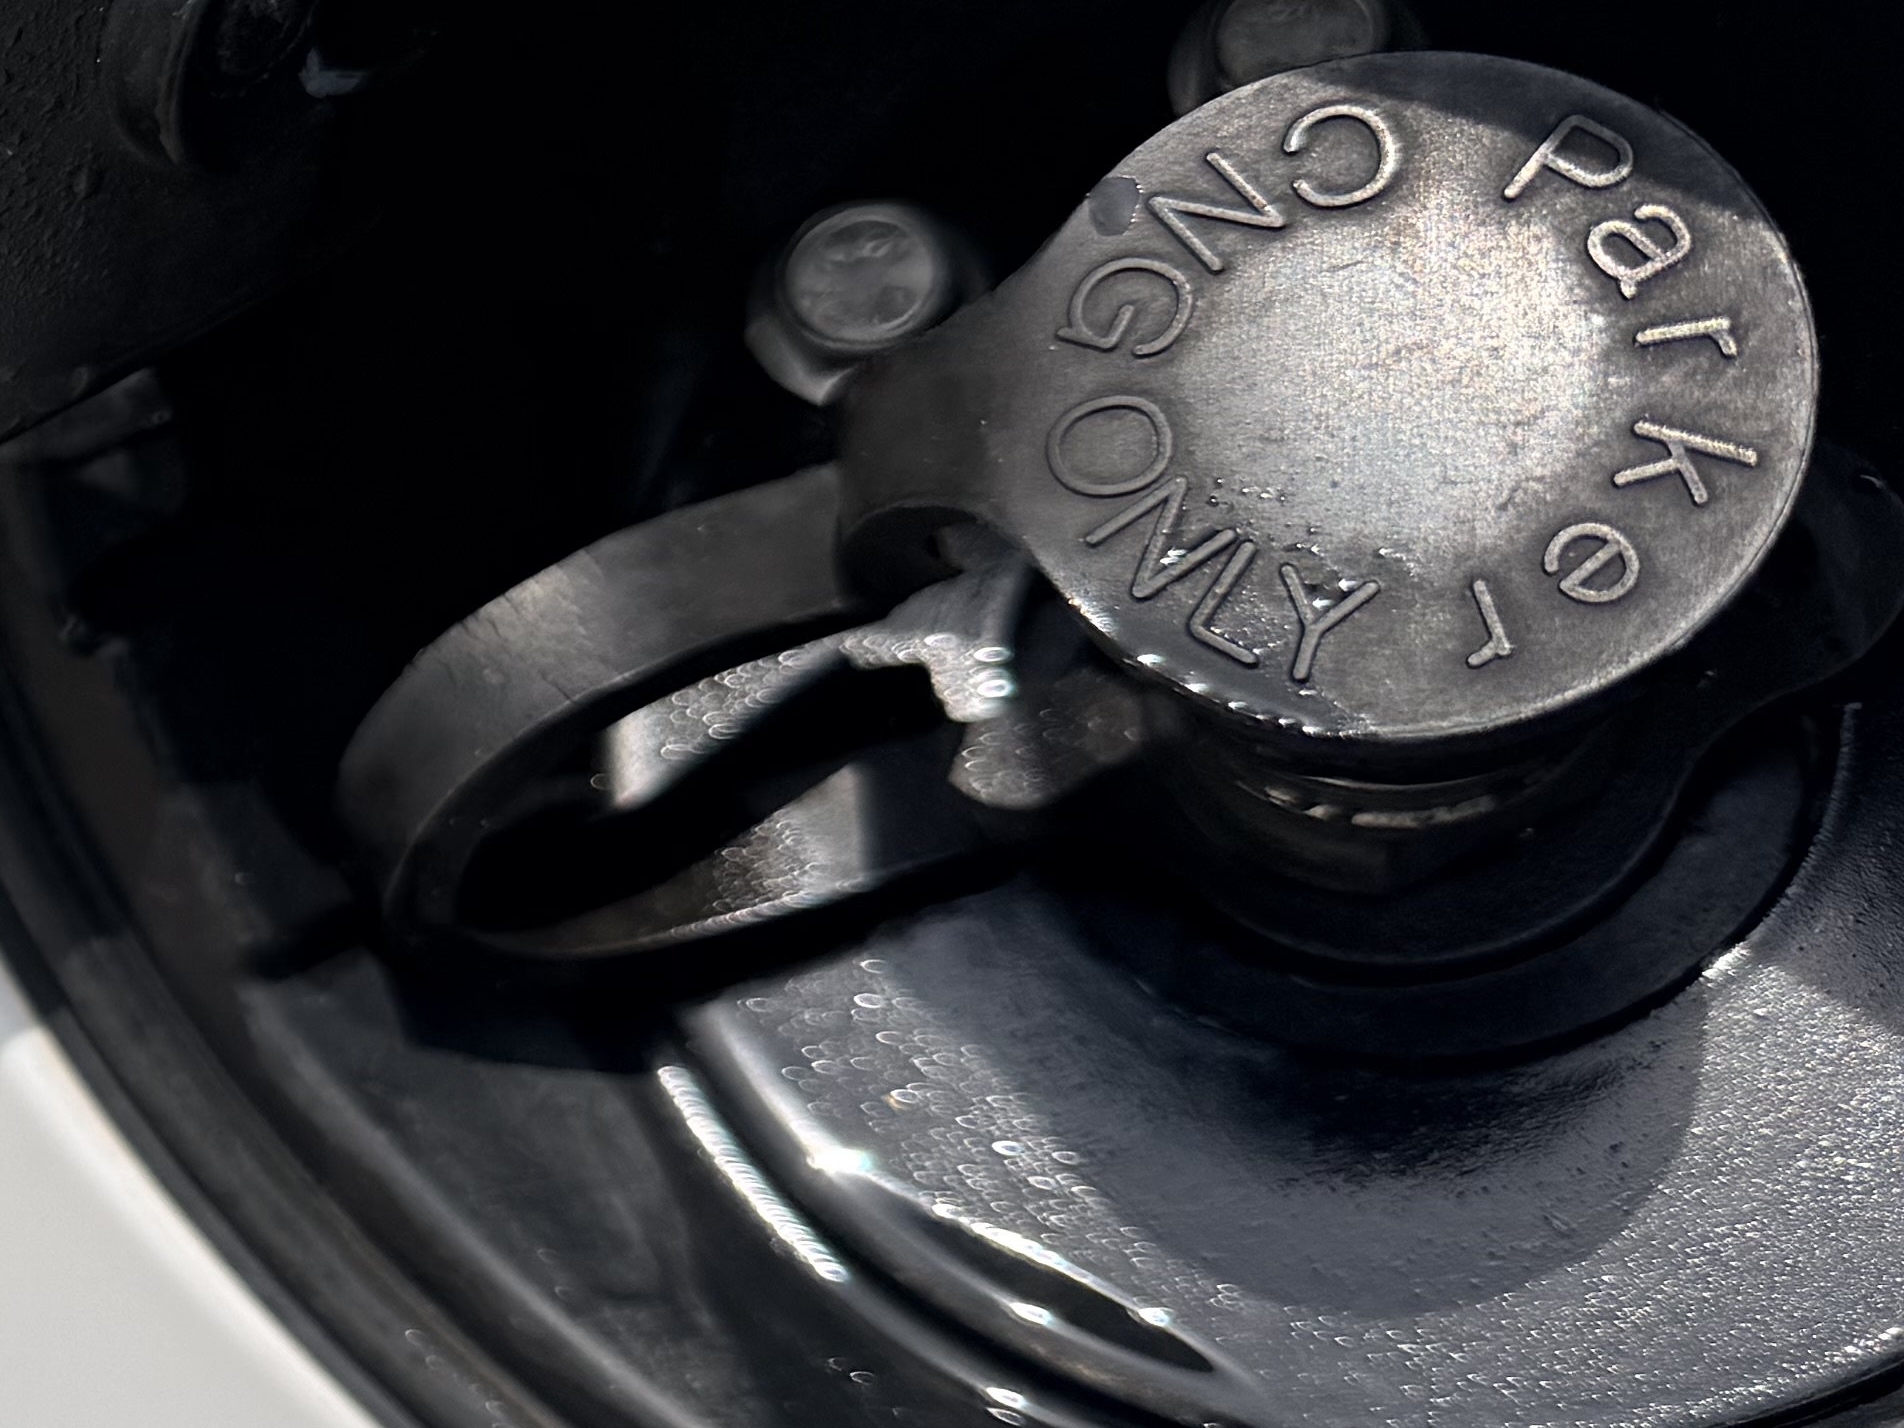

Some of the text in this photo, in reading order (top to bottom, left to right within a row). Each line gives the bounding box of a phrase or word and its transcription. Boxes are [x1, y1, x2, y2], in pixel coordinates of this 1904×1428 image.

[1046, 102, 1397, 683] CNG ONLY
[1465, 113, 1759, 669] Parker
